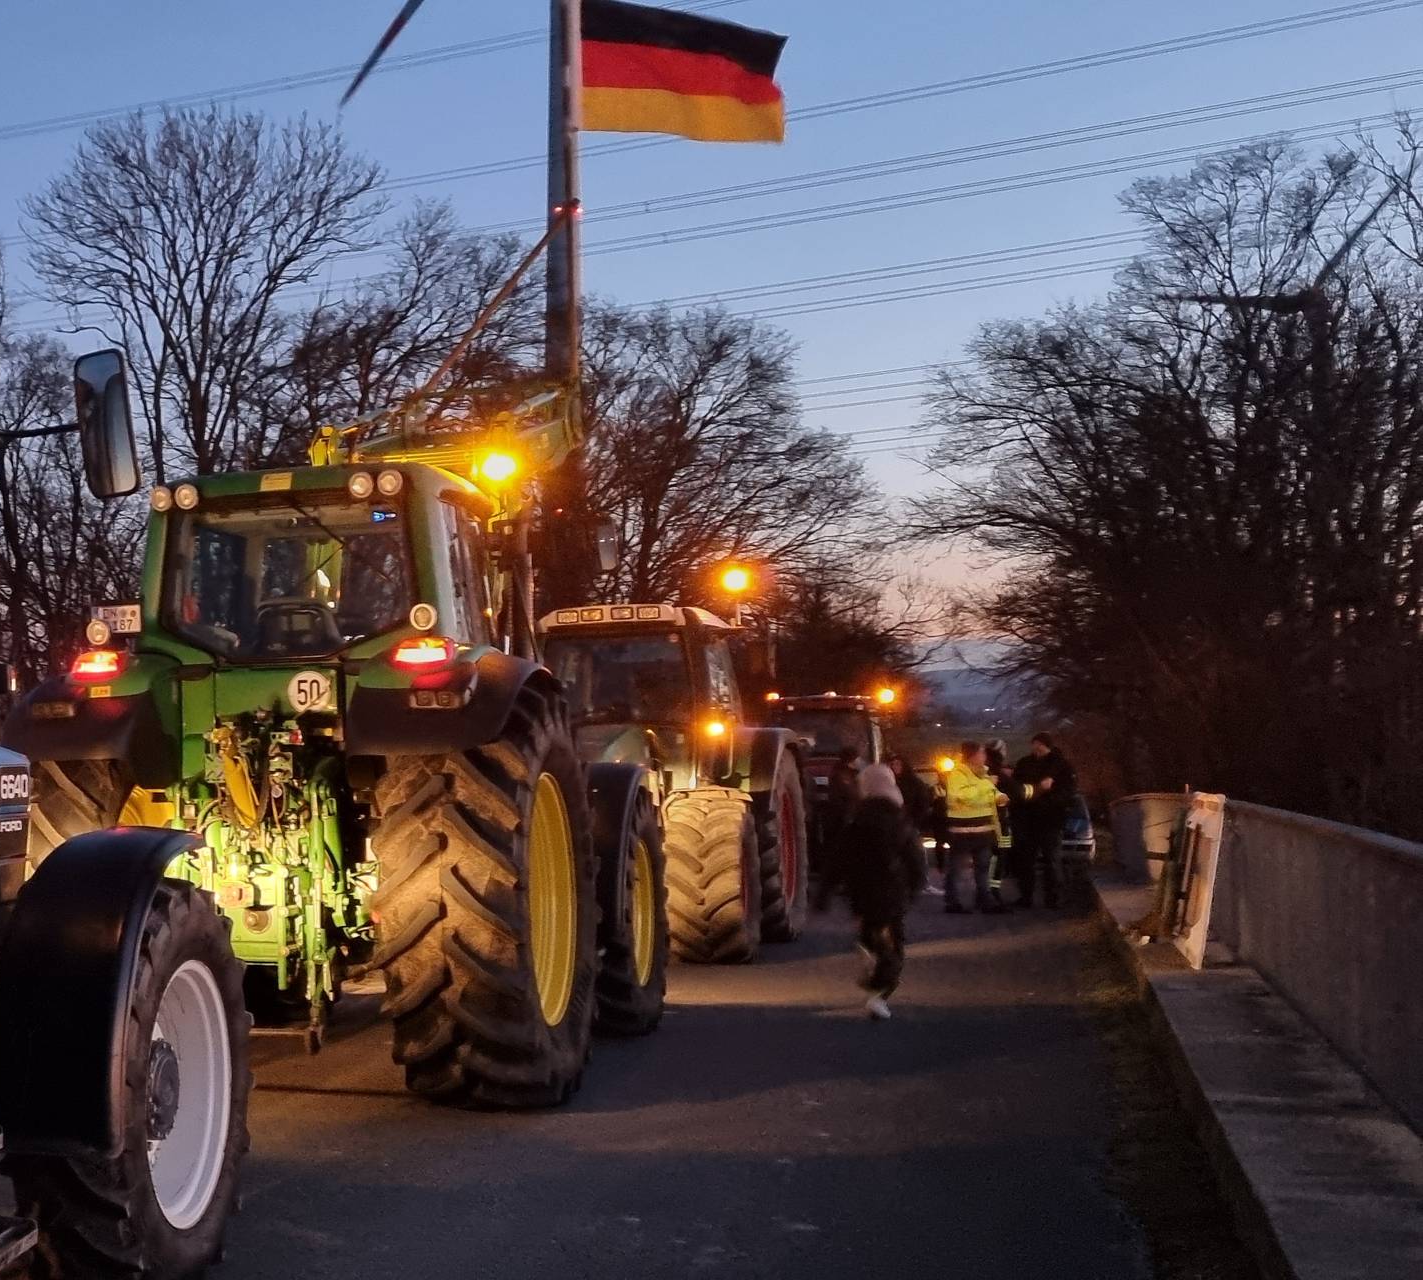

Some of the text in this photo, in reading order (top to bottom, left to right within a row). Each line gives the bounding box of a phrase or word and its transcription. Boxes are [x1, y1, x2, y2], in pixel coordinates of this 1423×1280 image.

[297, 679, 320, 706] 50
[0, 773, 29, 799] 6640
[0, 820, 23, 833] FORD
